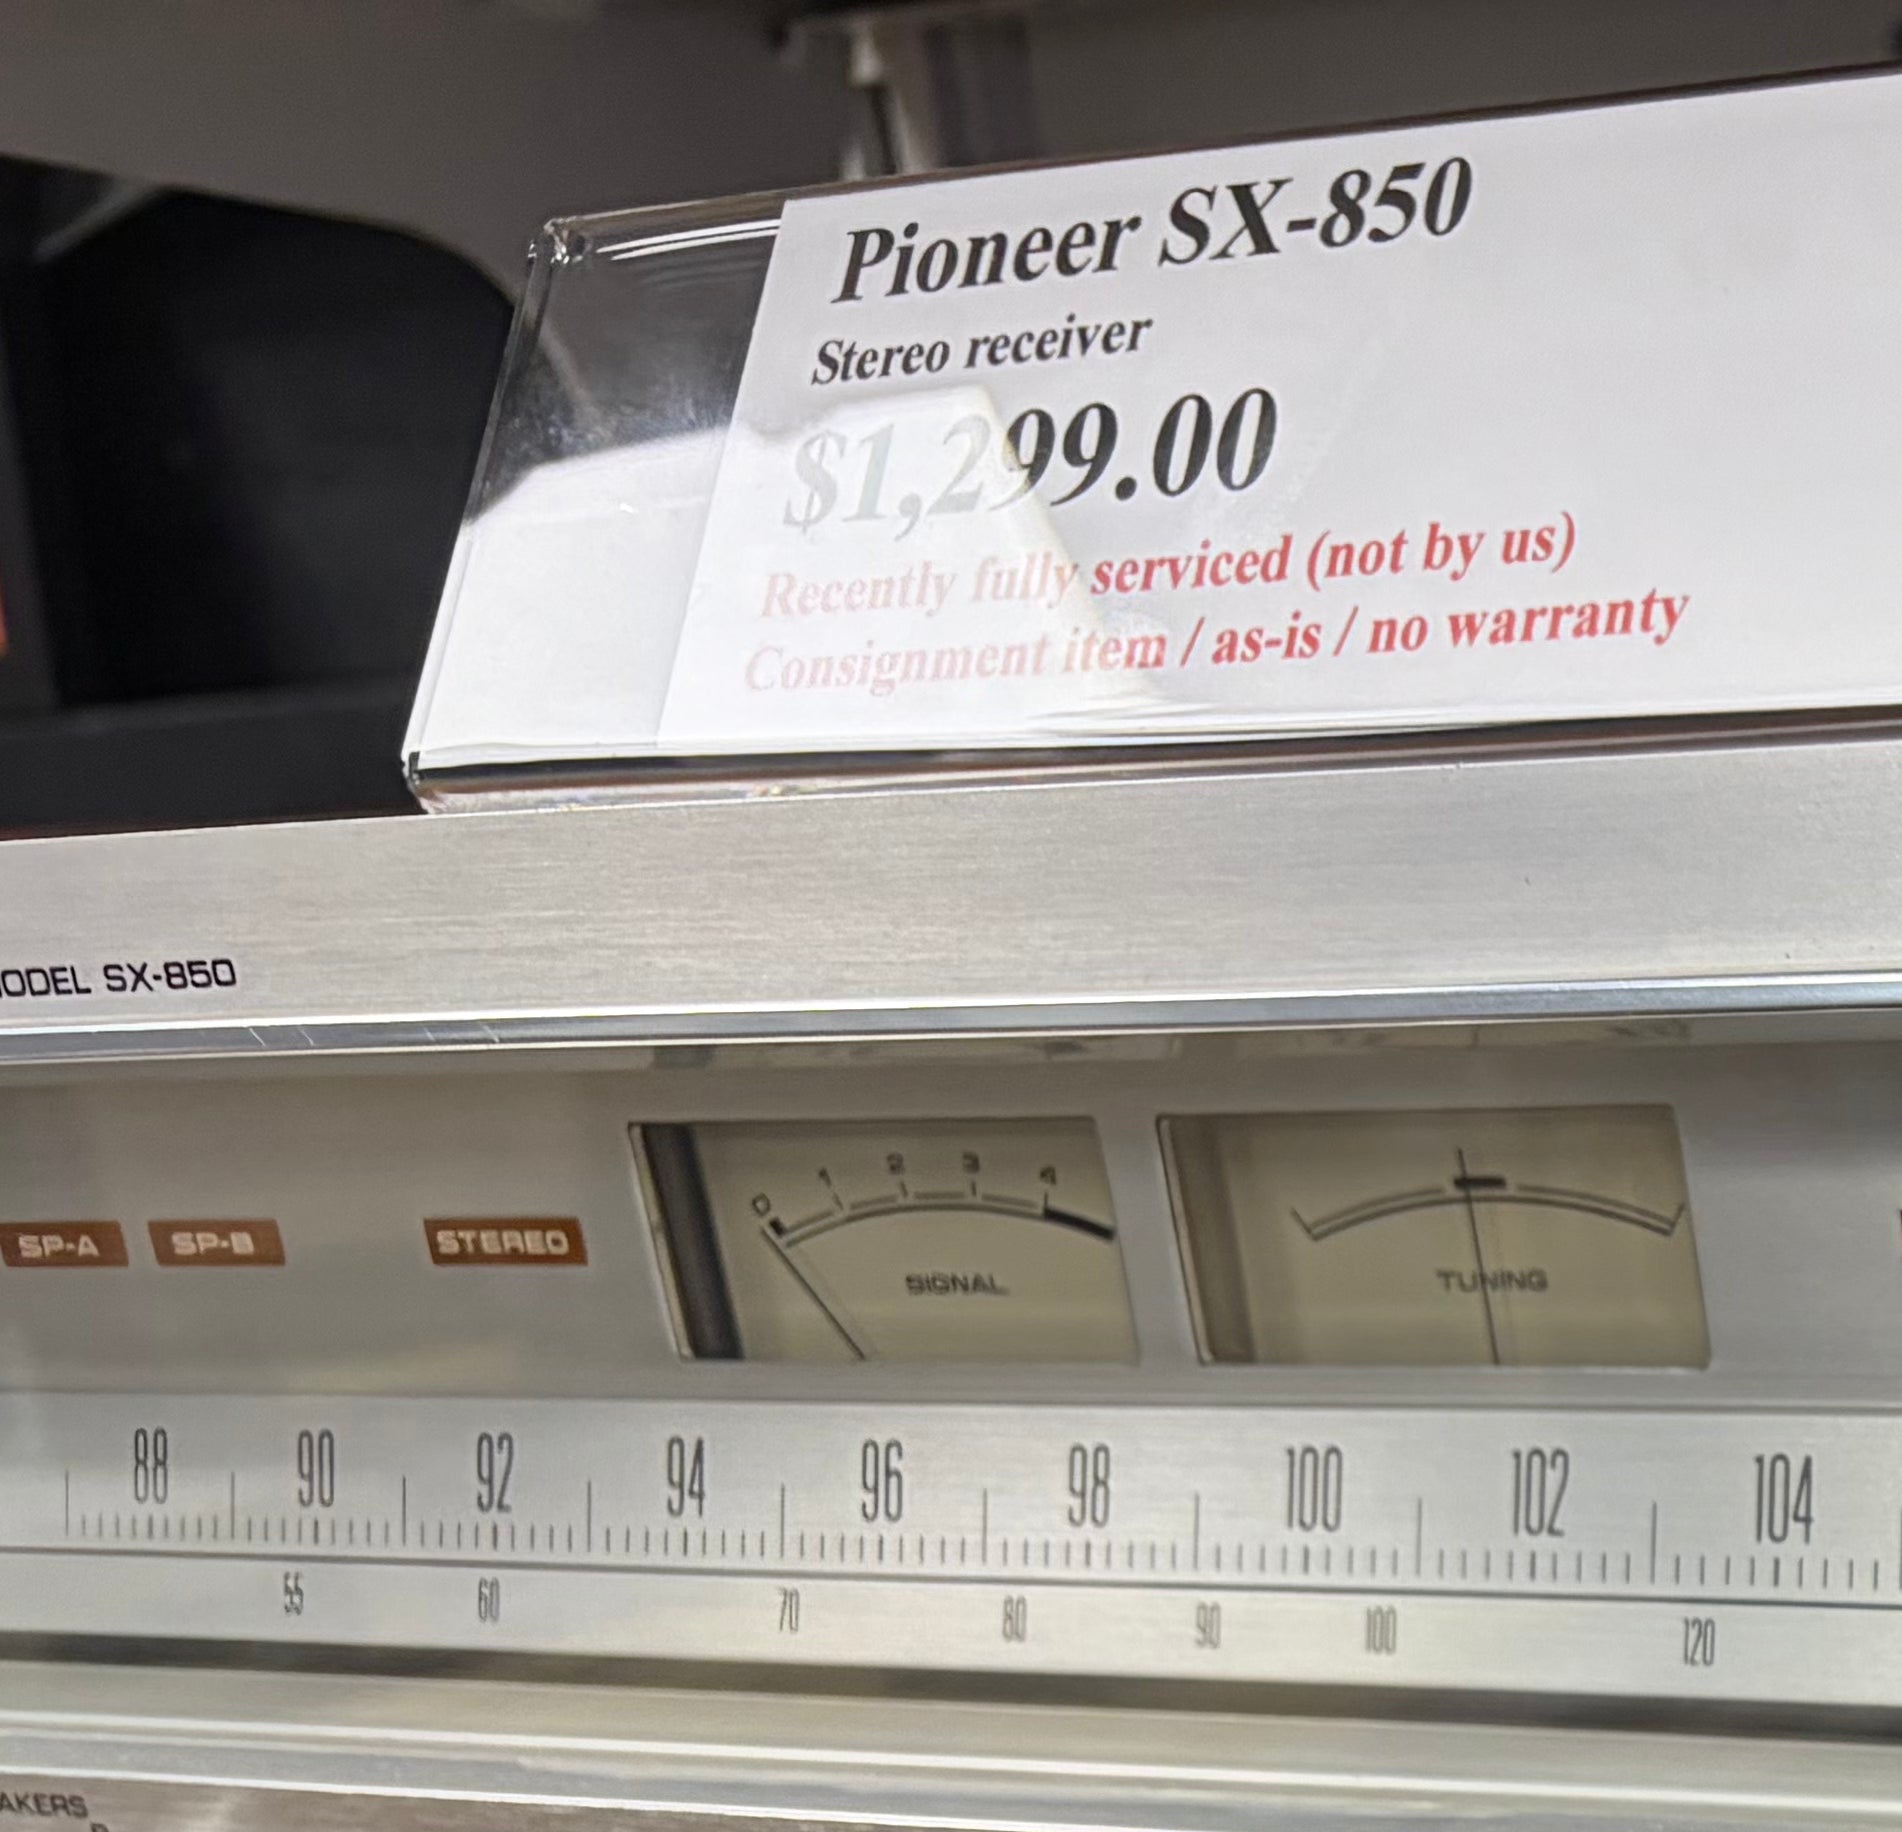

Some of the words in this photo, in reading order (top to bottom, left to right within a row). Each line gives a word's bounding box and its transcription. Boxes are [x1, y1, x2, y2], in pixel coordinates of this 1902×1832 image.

[830, 215, 1142, 303] Pioneer
[1158, 156, 1472, 267] SX-850
[811, 338, 949, 385] Stereo
[963, 313, 1153, 369] receiver
[783, 387, 1277, 540] $1,299.00
[762, 559, 958, 617] Recently
[970, 548, 1079, 600] fully
[1090, 533, 1292, 594] serviced
[1306, 528, 1409, 592] (not
[1423, 521, 1485, 581] by
[1501, 511, 1576, 574] us)
[744, 628, 1052, 697] Consignment
[1062, 624, 1167, 673] item
[1180, 617, 1204, 667] /
[1211, 612, 1321, 664] as-is
[1333, 605, 1359, 656] /
[1368, 614, 1427, 654] no
[1448, 587, 1690, 647] warranty
[0, 966, 92, 998] ODEL
[103, 959, 237, 993] SX-850
[18, 1234, 100, 1259] SP-A
[171, 1232, 255, 1255] SP-B
[436, 1229, 570, 1254] STEREO
[905, 1271, 1010, 1295] SIGNAL
[1436, 1269, 1549, 1293] TUNING
[134, 1427, 168, 1503] 88
[298, 1430, 335, 1507] 90
[477, 1432, 515, 1513] 92
[667, 1436, 705, 1518] 94
[862, 1439, 903, 1522] 96
[1068, 1444, 1111, 1528] 98
[1286, 1445, 1343, 1532] 100
[1512, 1447, 1569, 1537] 102
[1754, 1453, 1814, 1544] 104
[284, 1571, 304, 1617] 55
[478, 1578, 500, 1623] 60
[778, 1587, 800, 1634] 70
[1002, 1595, 1027, 1642] 80
[1196, 1604, 1221, 1650] 90
[1366, 1606, 1397, 1655] 100
[1682, 1617, 1715, 1668] 120
